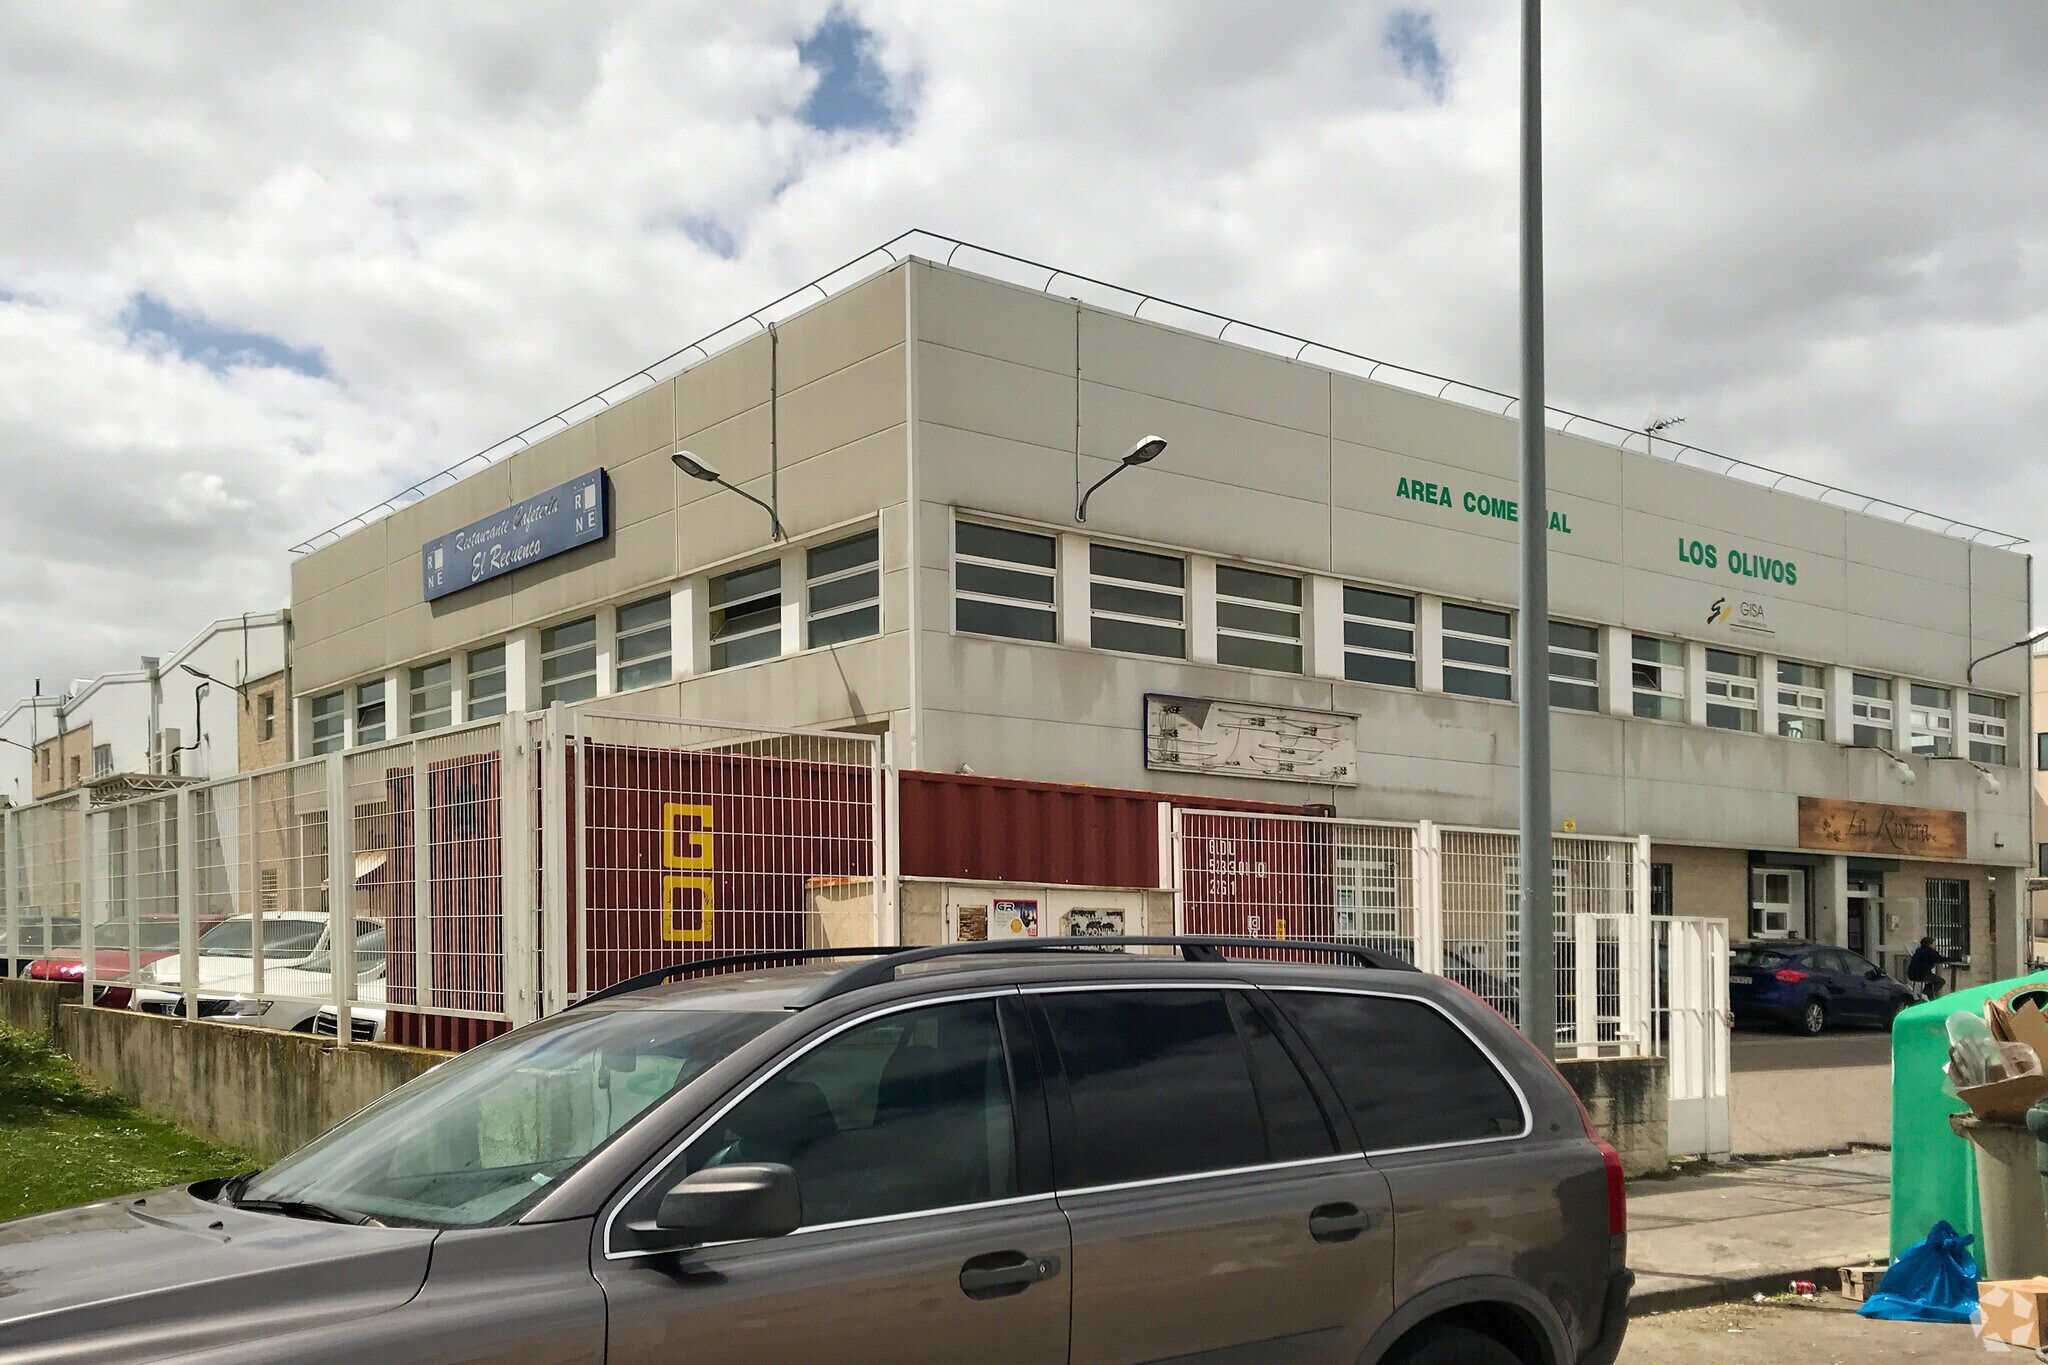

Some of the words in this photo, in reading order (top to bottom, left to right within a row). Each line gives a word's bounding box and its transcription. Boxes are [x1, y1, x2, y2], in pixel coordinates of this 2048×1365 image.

[1396, 476, 1452, 508] AREA
[1463, 491, 1572, 534] COMEAL
[455, 519, 510, 554] Restaurante
[471, 551, 487, 582] El
[489, 539, 541, 572] Recuenco
[1678, 537, 1718, 569] LOS
[1728, 549, 1798, 586] OLIVOS
[1740, 601, 1765, 619] GISA
[1845, 809, 1869, 837] La
